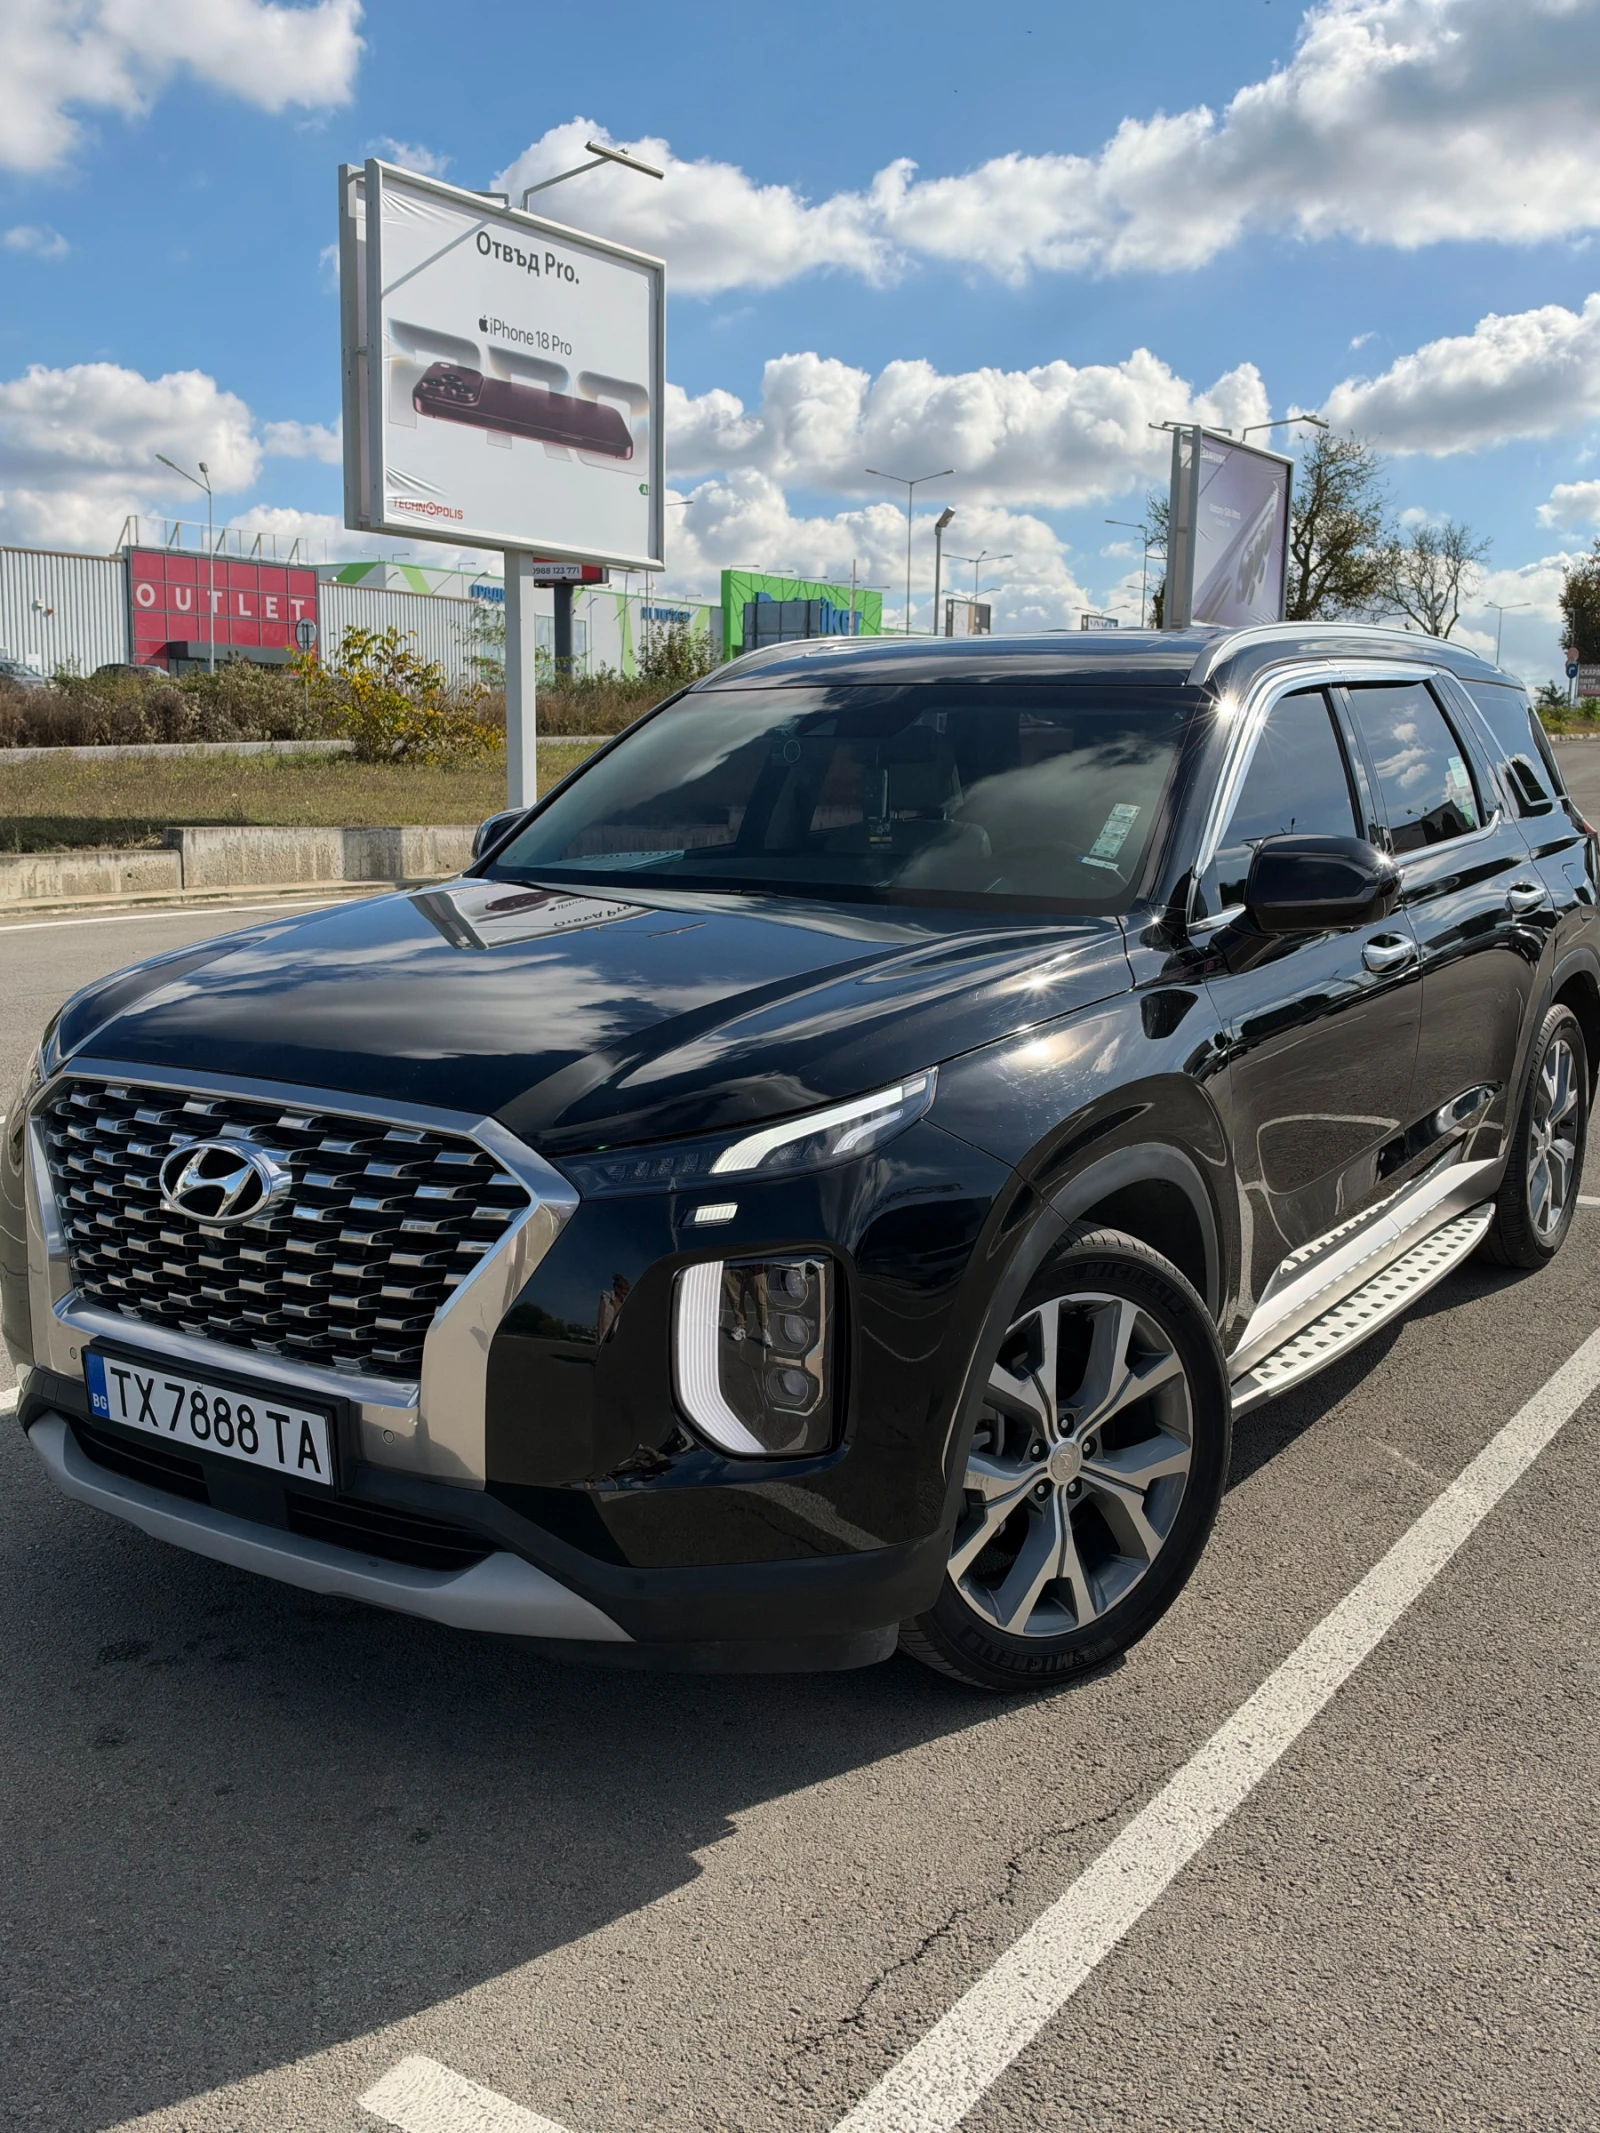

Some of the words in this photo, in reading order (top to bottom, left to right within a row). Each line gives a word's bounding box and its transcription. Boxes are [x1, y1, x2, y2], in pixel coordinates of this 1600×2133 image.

[476, 231, 540, 277] Отвъд
[545, 252, 580, 285] Pro.
[489, 317, 534, 346] iPhone
[536, 330, 550, 350] 18
[552, 334, 572, 356] Pro
[136, 583, 305, 621] OUTLET
[92, 1392, 107, 1410] BG
